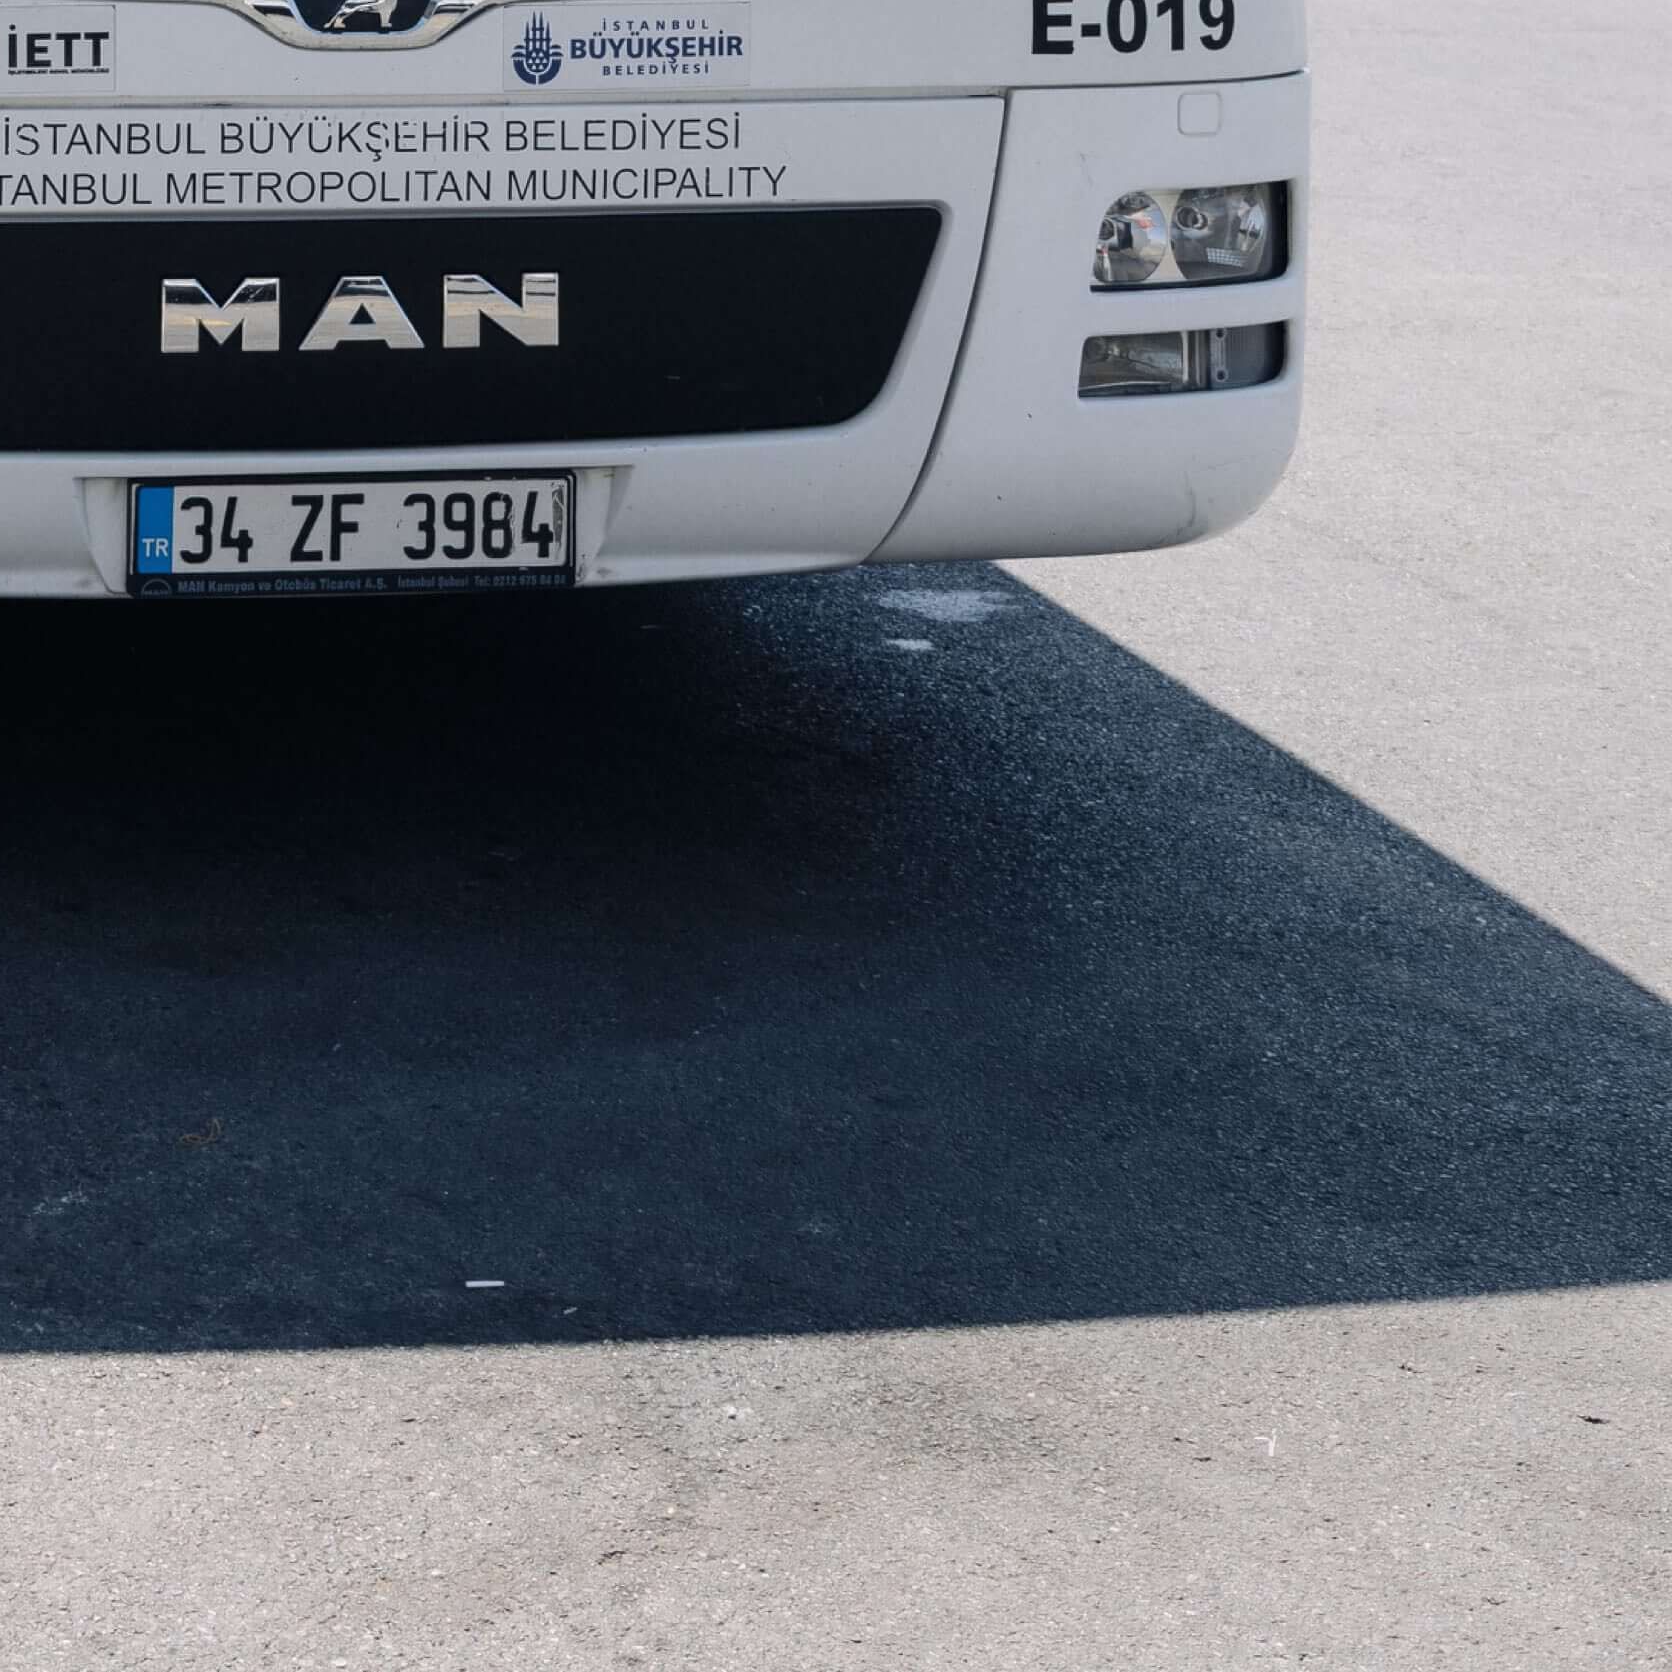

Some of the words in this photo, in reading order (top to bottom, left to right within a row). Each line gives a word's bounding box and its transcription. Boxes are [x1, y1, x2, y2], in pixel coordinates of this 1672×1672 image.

[602, 17, 710, 32] İSTANBUL
[8, 23, 110, 68] İETT
[570, 29, 744, 64] BÜYÜKŞEHİR
[602, 60, 710, 76] BELEDİYESİ
[4, 117, 206, 156] İSTANBUL
[221, 115, 490, 162] BÜYÜKŞEHİR
[505, 111, 740, 152] BELEDİYESİ
[166, 169, 491, 205] METROPOLITAN
[507, 165, 787, 201] MUNICIPALITY
[160, 272, 560, 353] MAN
[142, 537, 169, 557] TR
[180, 496, 253, 564] 34
[290, 493, 365, 563] ZF
[402, 491, 554, 560] 3984
